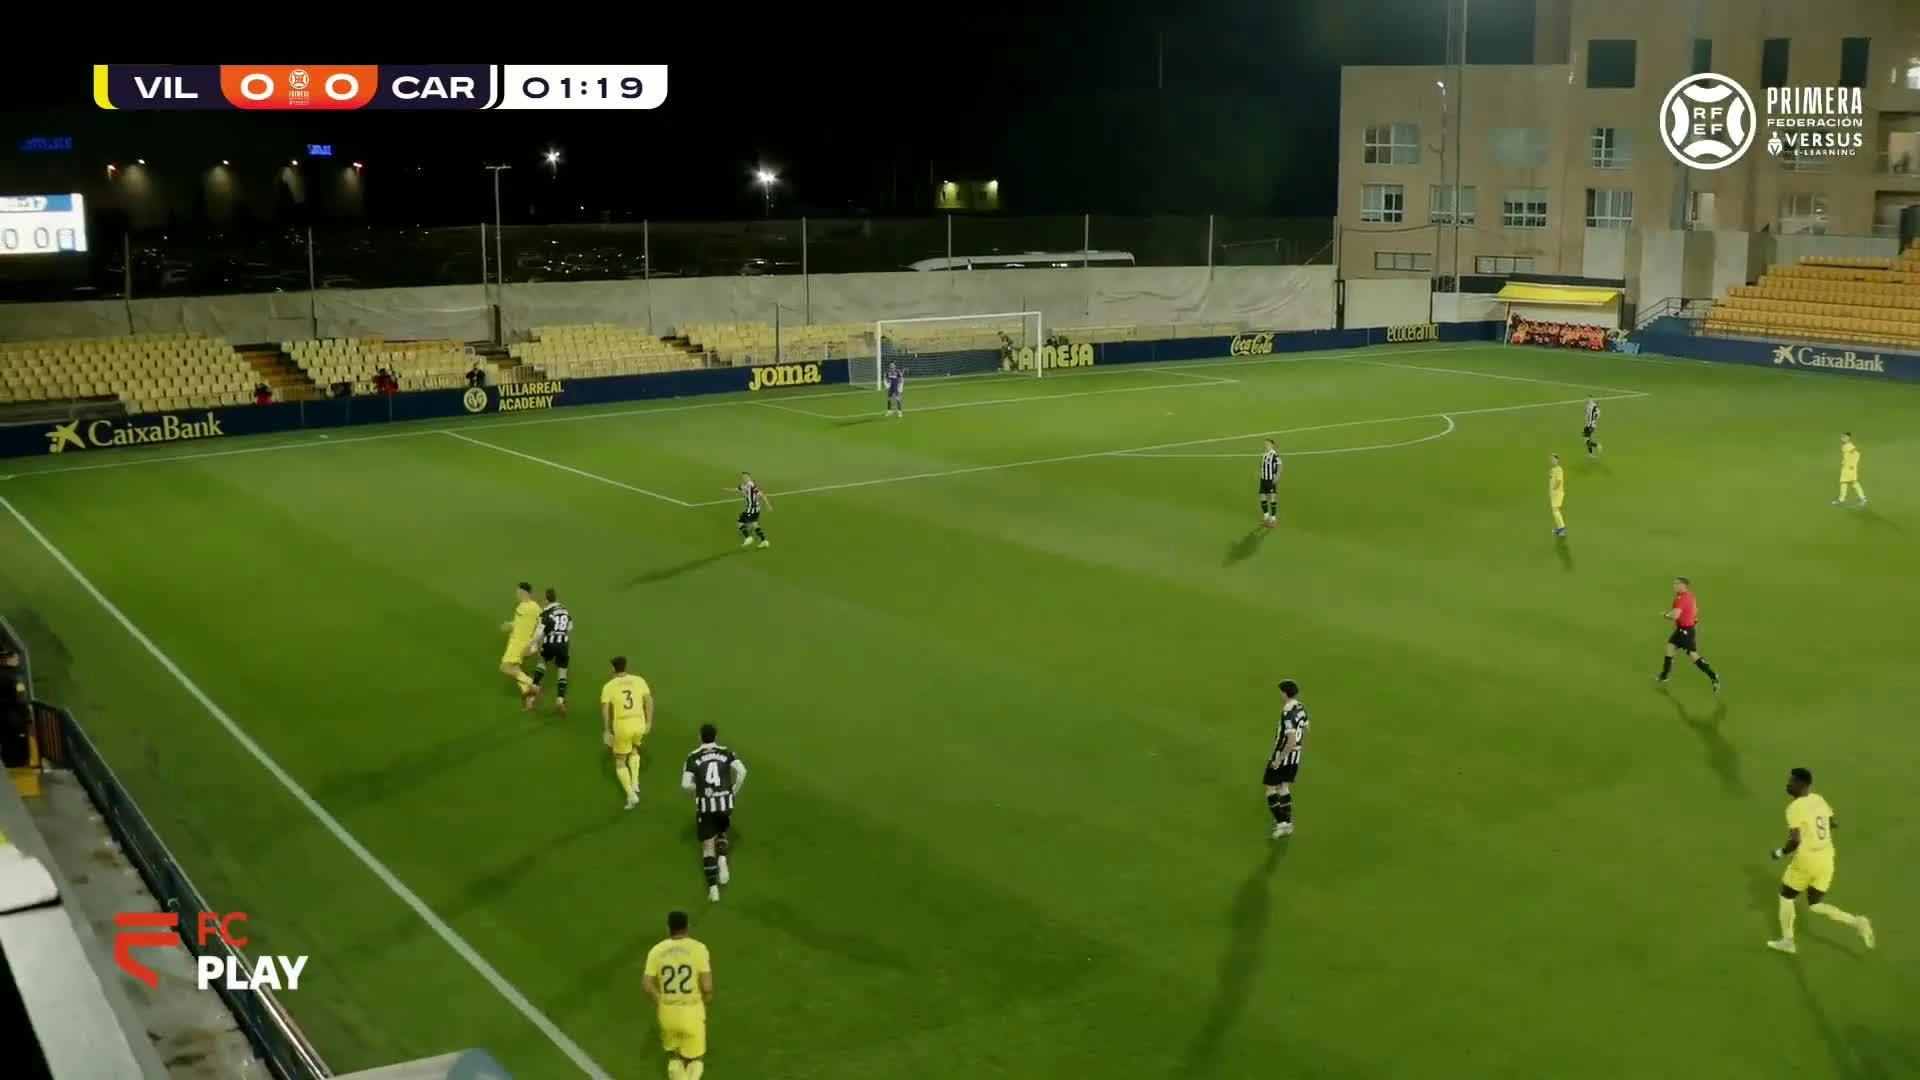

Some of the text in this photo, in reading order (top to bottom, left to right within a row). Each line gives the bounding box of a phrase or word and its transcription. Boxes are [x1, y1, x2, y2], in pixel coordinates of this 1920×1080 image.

[1798, 347, 1884, 372] CaixaBank
[498, 381, 564, 397] VILLARREAL
[499, 395, 553, 412] ACADEMY
[88, 411, 224, 447] CaixaBank
[553, 614, 568, 632] 18
[621, 689, 633, 710] 3
[705, 761, 720, 787] 4
[1815, 815, 1827, 841] 8
[661, 964, 692, 994] 22
